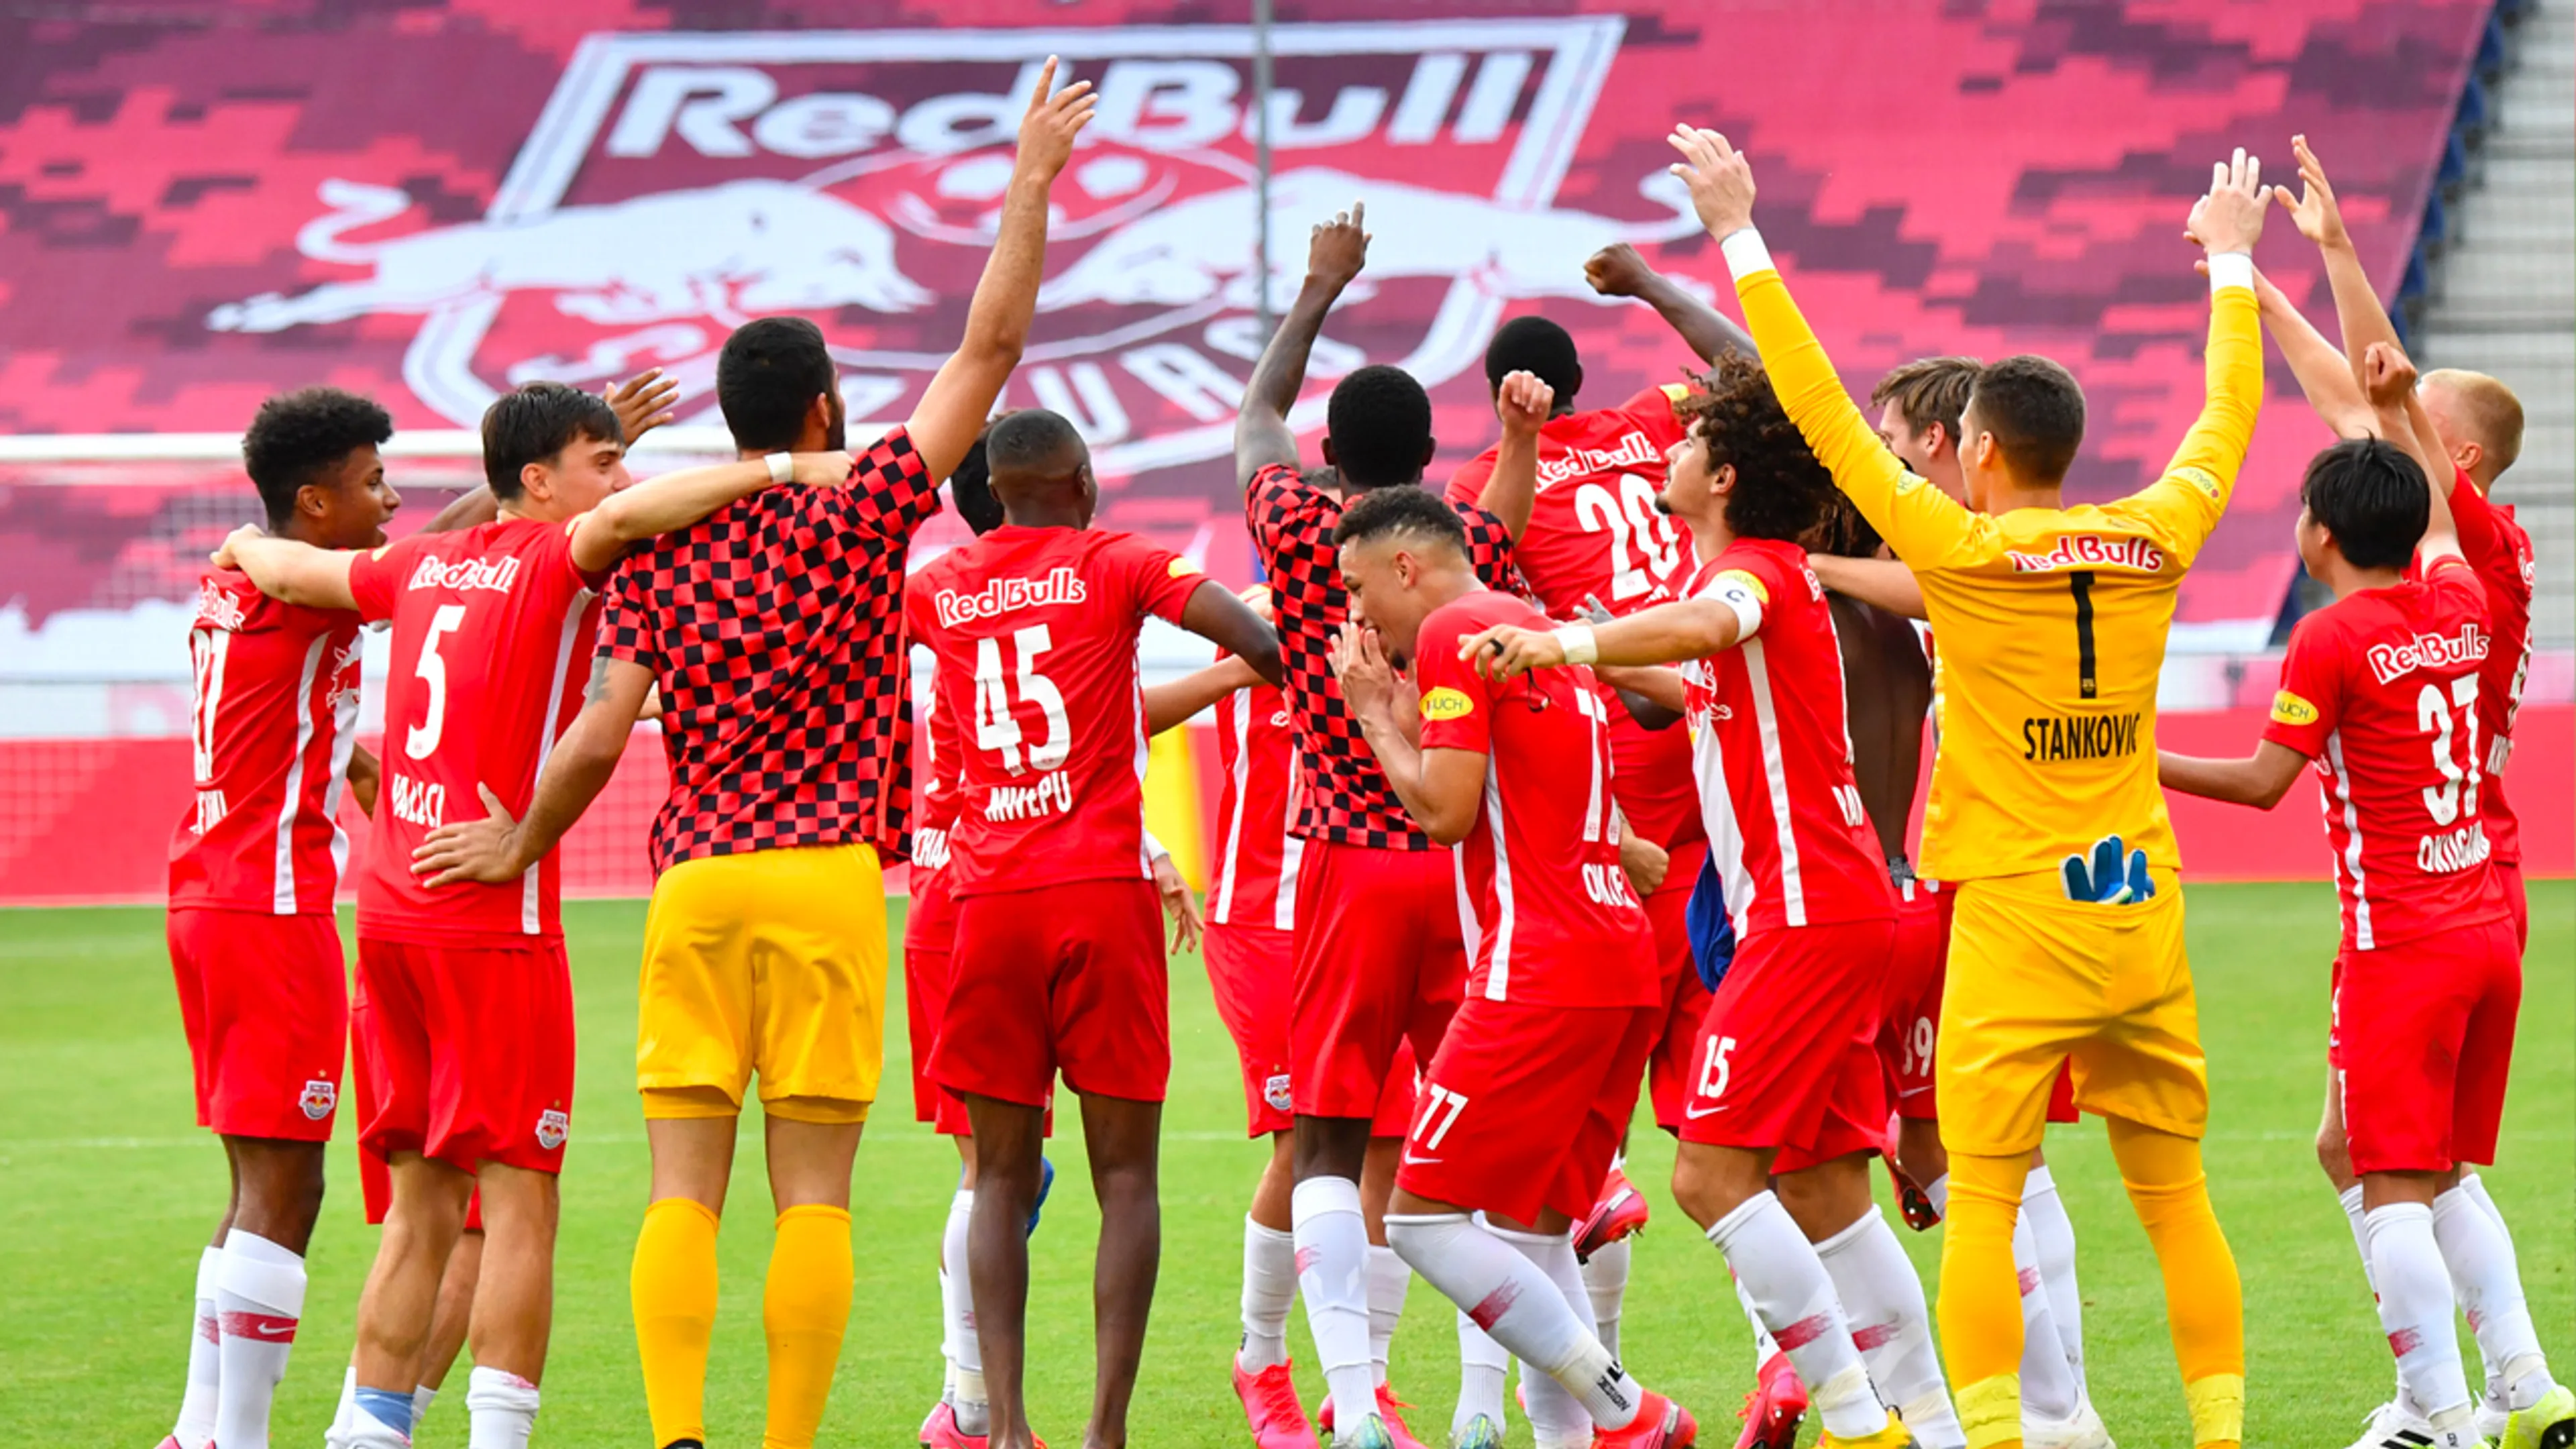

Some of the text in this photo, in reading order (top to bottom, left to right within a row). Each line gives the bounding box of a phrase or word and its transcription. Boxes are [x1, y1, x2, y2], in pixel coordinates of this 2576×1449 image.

[1574, 472, 1680, 602] 20
[1725, 589, 1746, 602] C
[404, 604, 466, 760] 5
[2070, 570, 2096, 699] 1
[974, 623, 1071, 778] 45
[2023, 712, 2141, 761] STANKOVIC
[2417, 672, 2481, 826] 37
[1411, 1083, 1469, 1150] 77
[1697, 1034, 1737, 1099] 15
